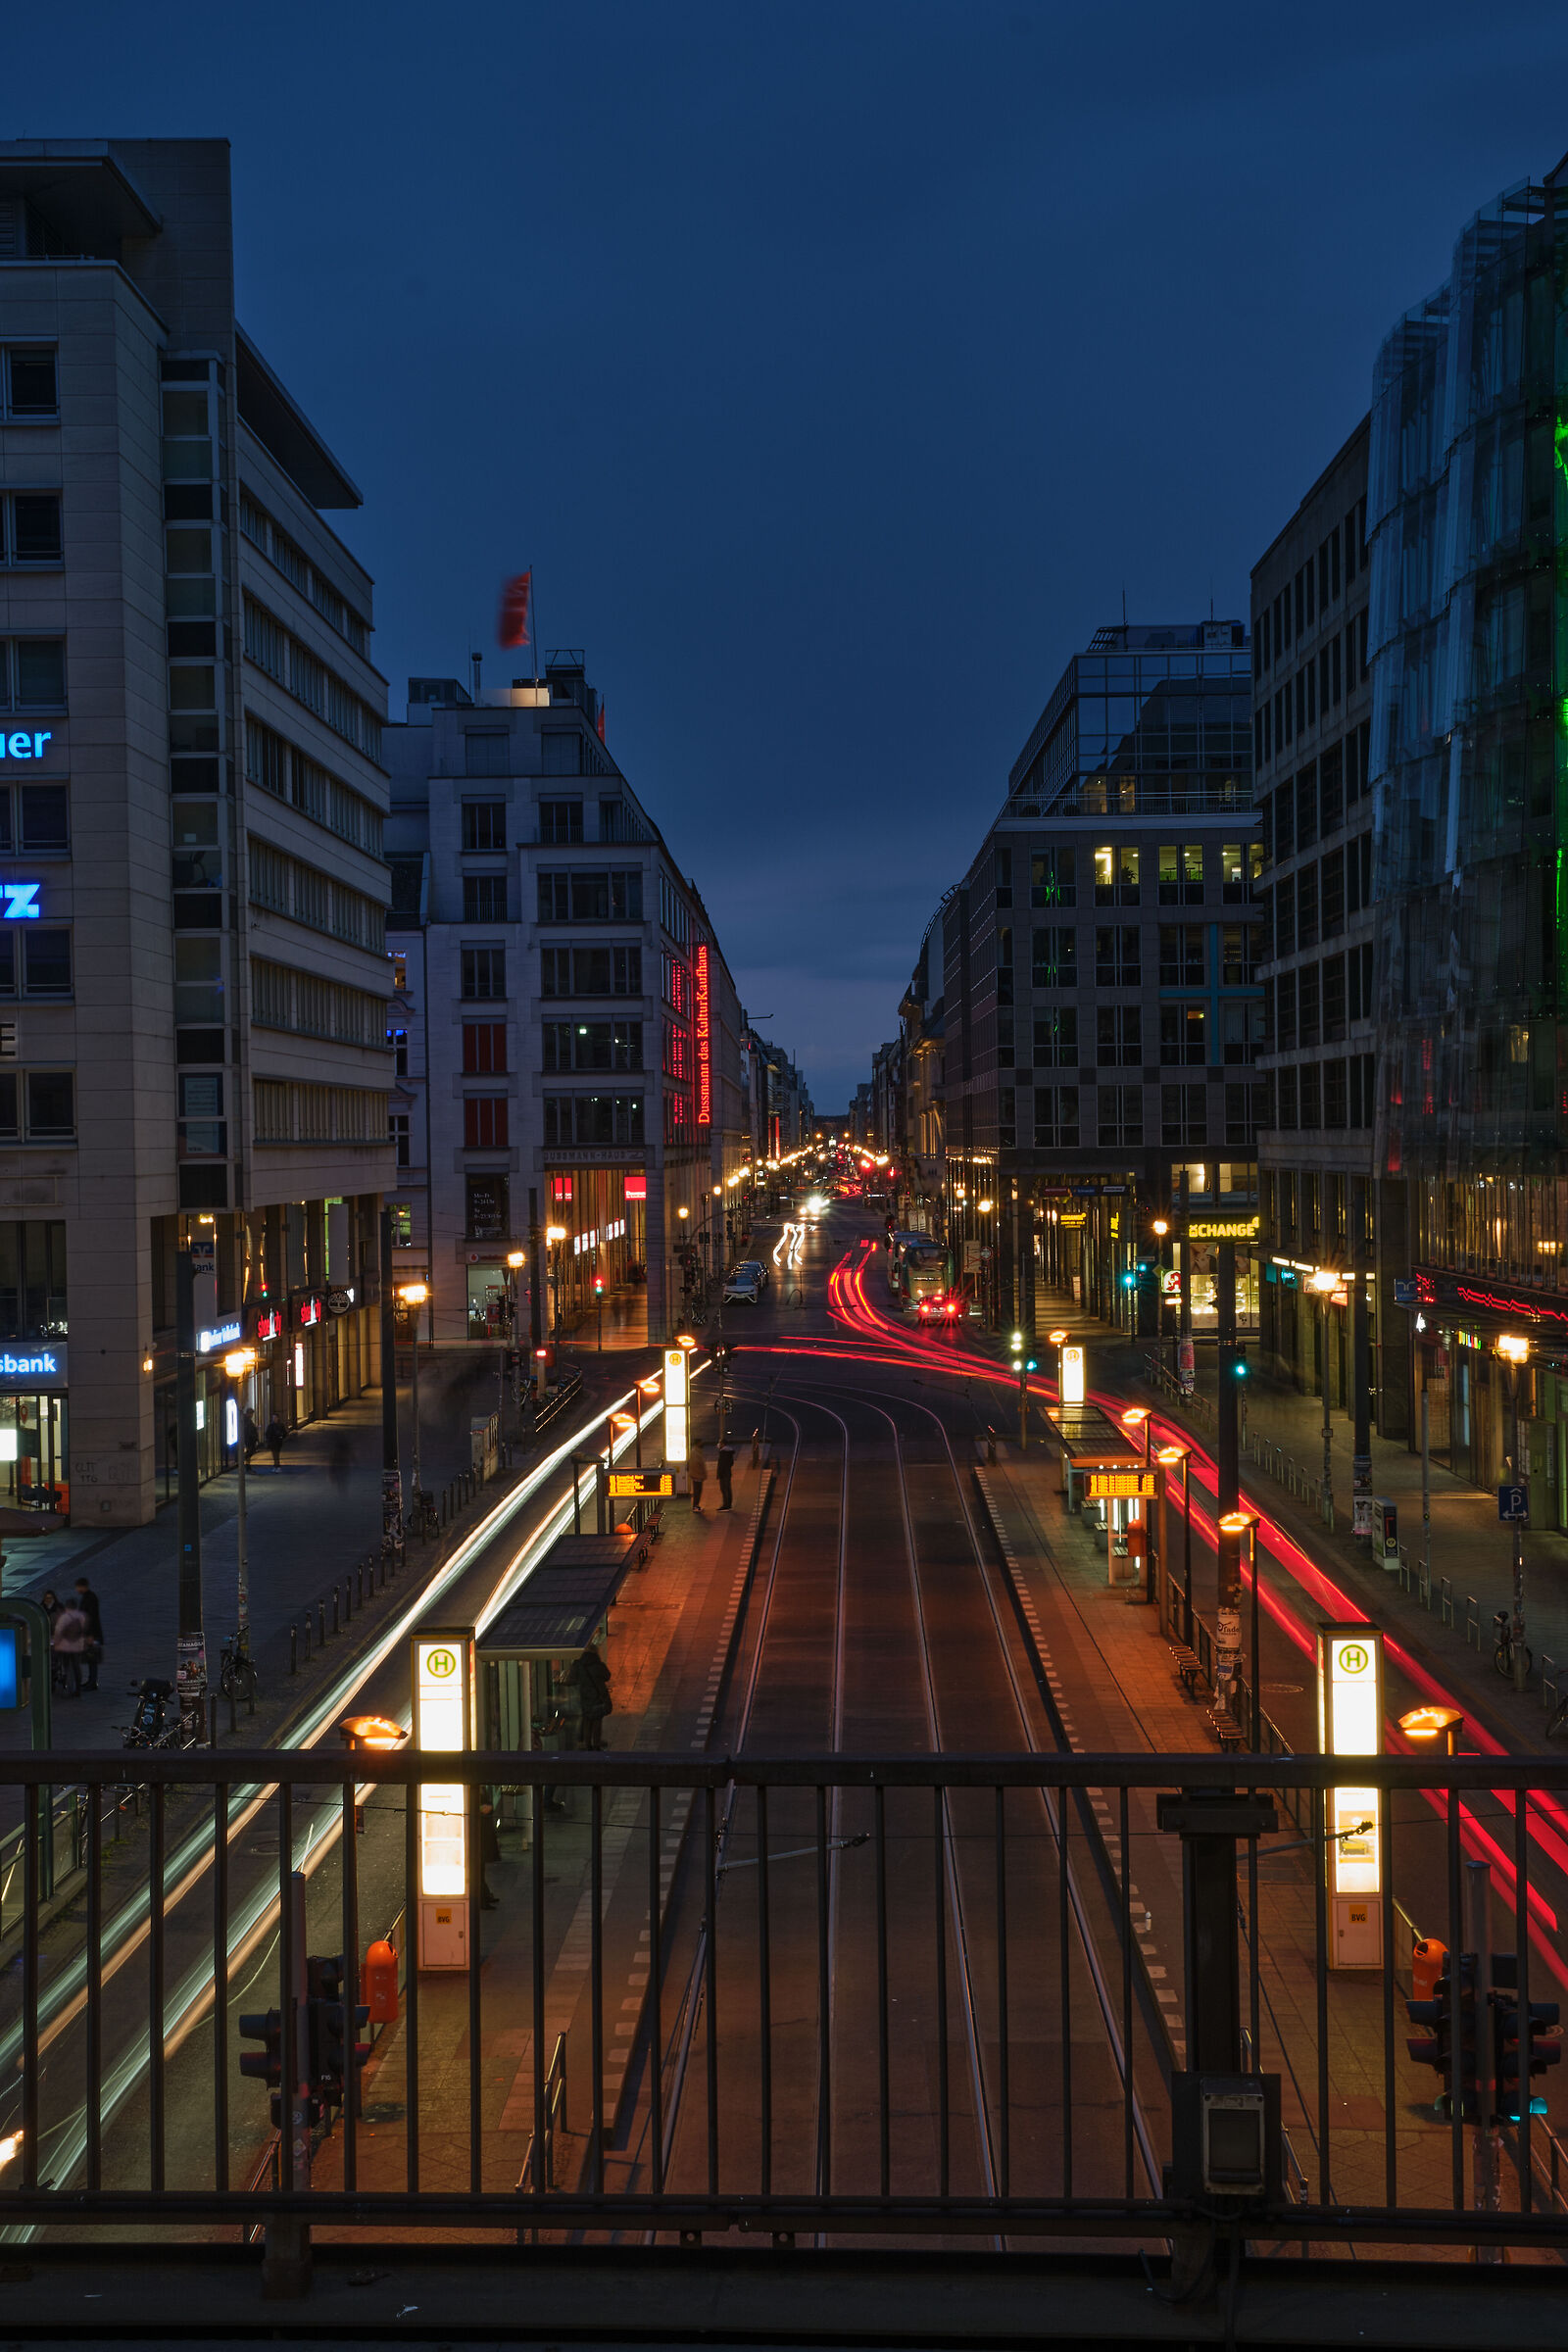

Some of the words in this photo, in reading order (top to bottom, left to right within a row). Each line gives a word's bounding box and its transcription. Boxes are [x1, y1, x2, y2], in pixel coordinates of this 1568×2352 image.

[696, 946, 709, 1039] KulturKaufhaus
[697, 1041, 710, 1061] das
[698, 1063, 710, 1124] Dussmann
[0, 1353, 57, 1373] bank
[1510, 1494, 1522, 1512] P
[1351, 1913, 1366, 1922] BVG
